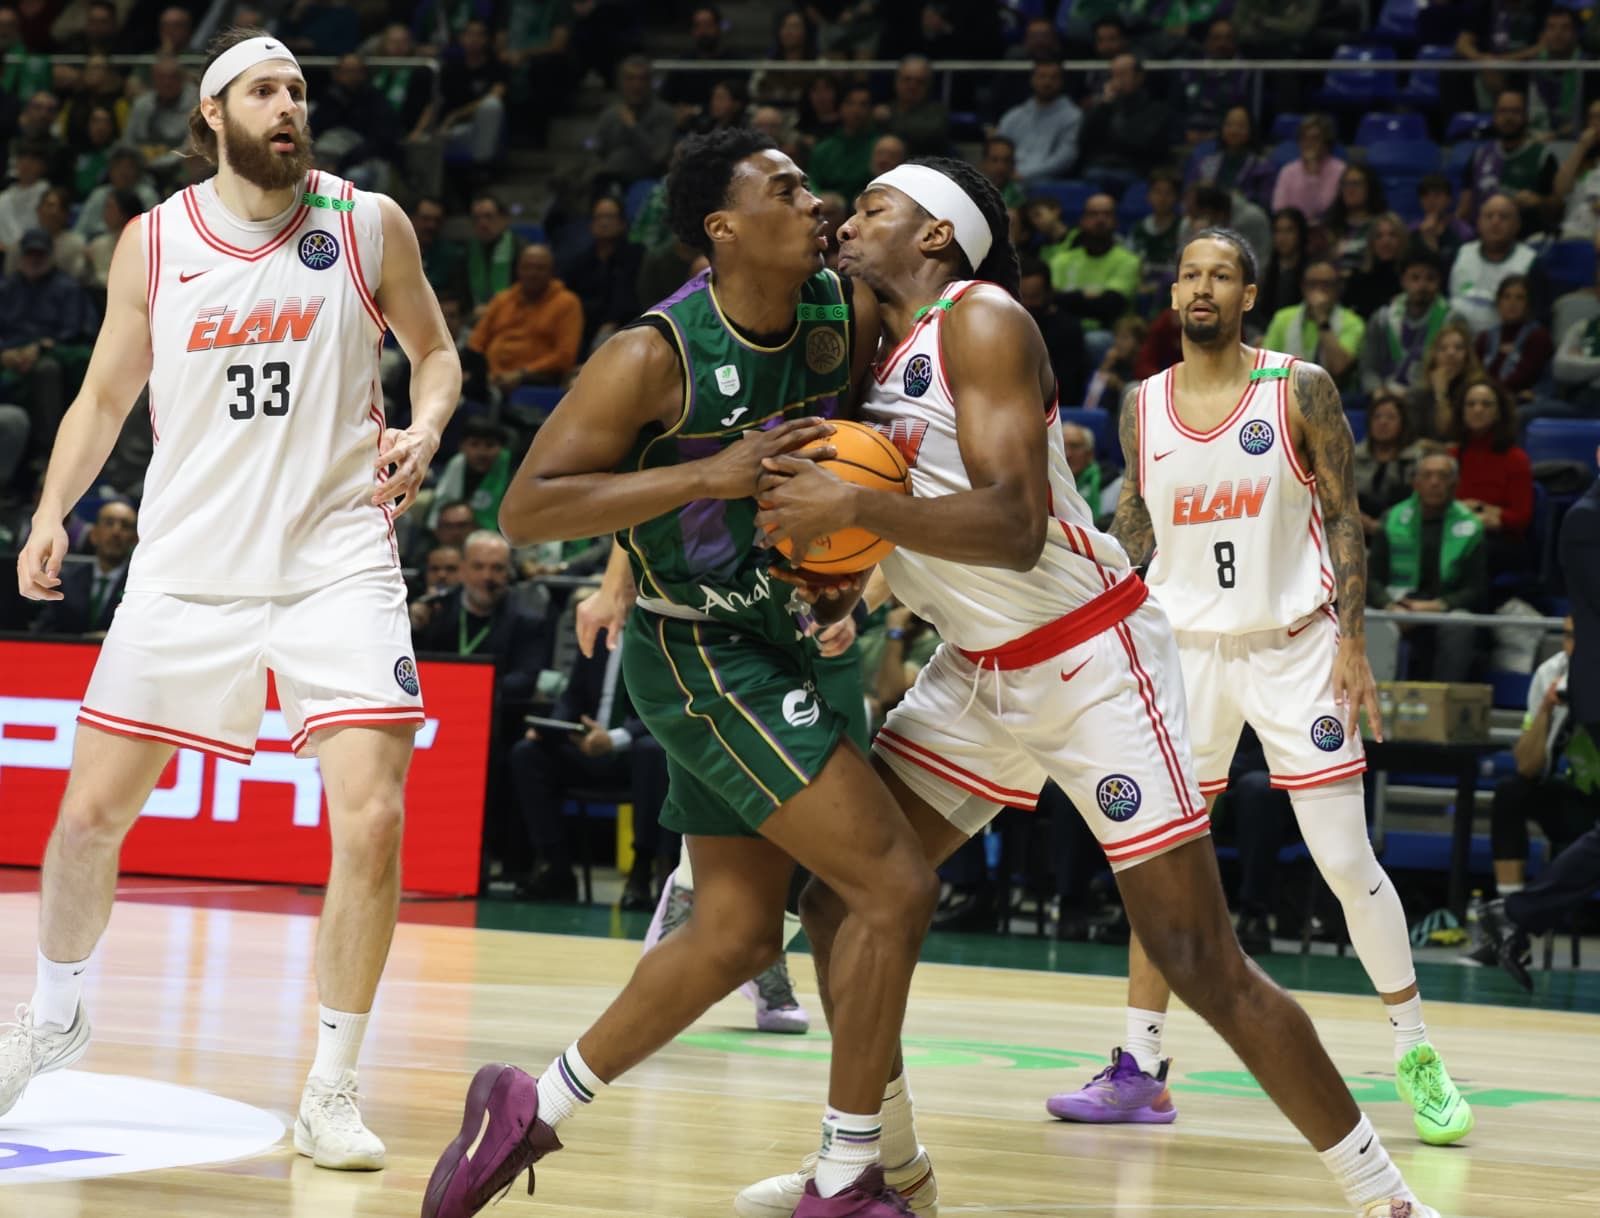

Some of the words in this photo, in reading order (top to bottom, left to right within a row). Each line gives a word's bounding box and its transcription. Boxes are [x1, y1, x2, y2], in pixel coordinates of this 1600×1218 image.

[186, 295, 326, 352] ELAN
[226, 361, 291, 420] 33
[1172, 475, 1272, 526] ELAN
[1213, 541, 1236, 588] 8
